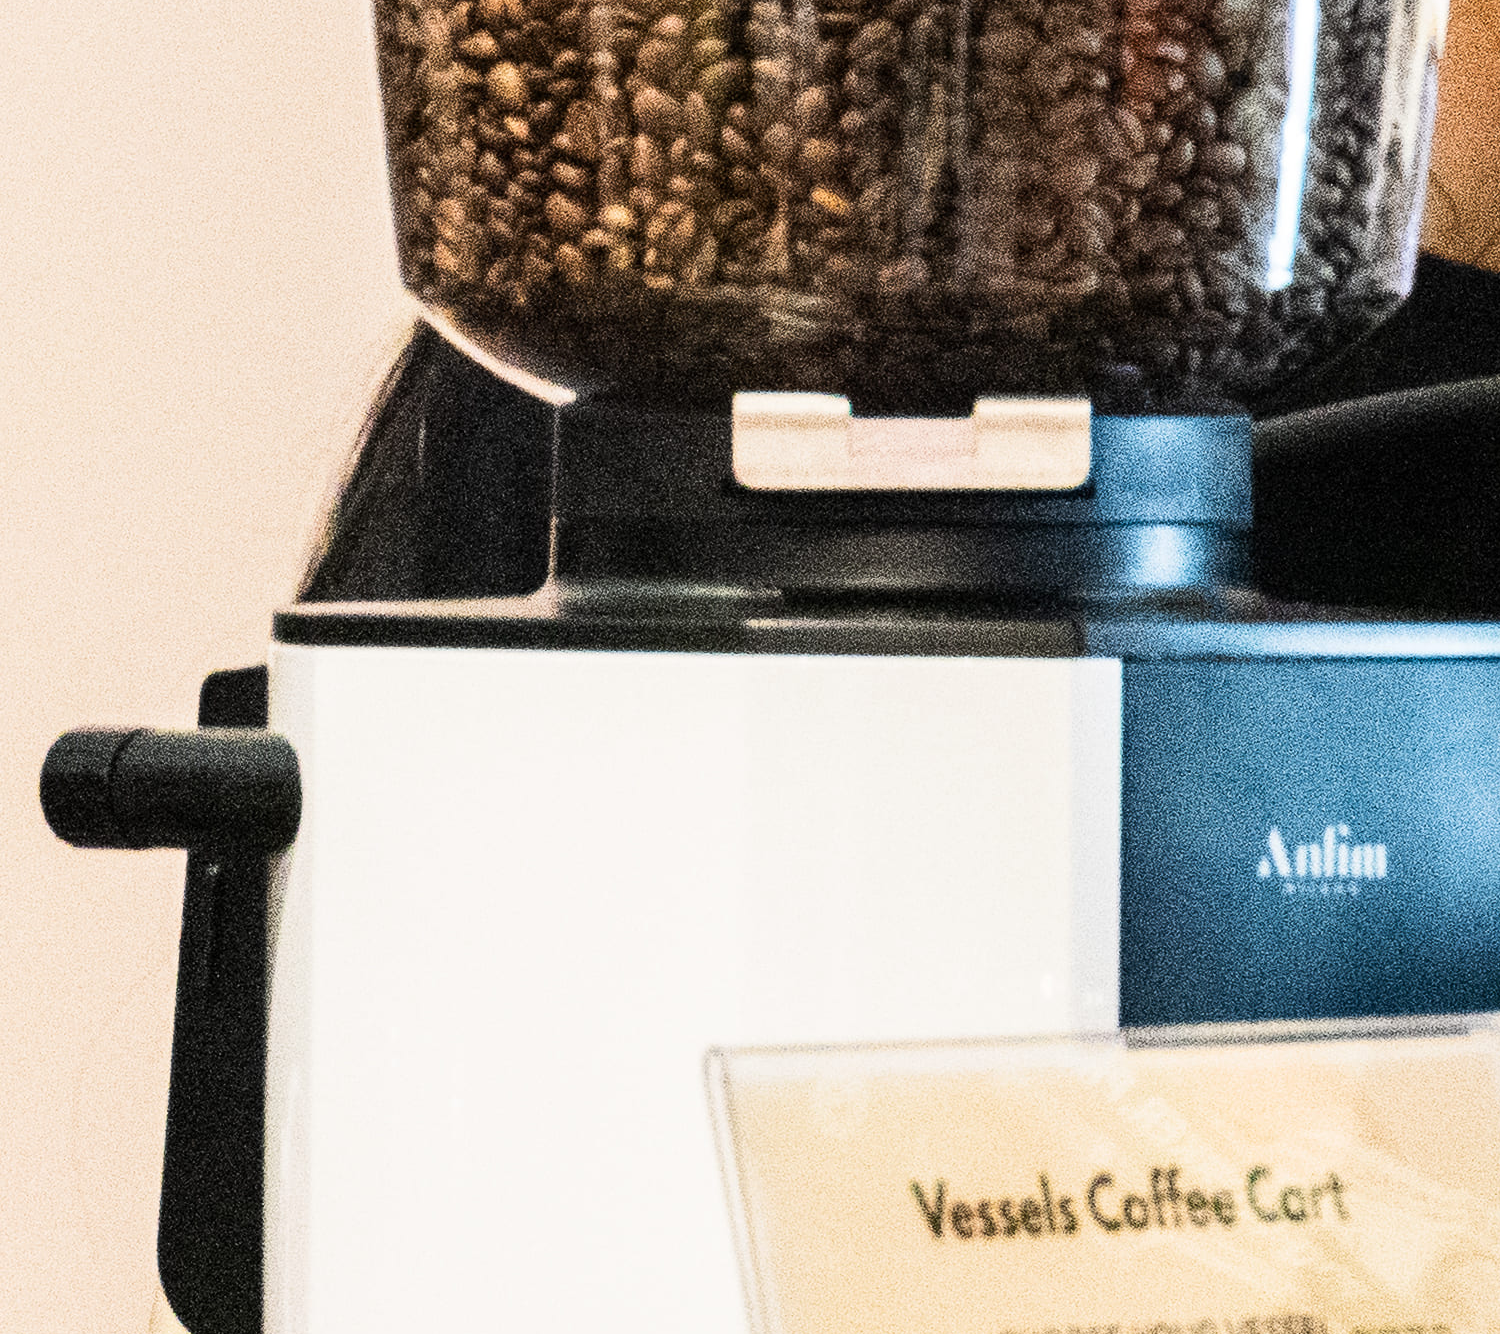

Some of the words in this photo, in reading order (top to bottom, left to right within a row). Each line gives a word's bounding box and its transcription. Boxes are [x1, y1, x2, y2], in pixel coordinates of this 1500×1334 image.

[1257, 823, 1387, 879] Anfim
[912, 1174, 1077, 1237] Vessels
[1088, 1168, 1235, 1231] Coffee
[1248, 1167, 1347, 1221] Cart
